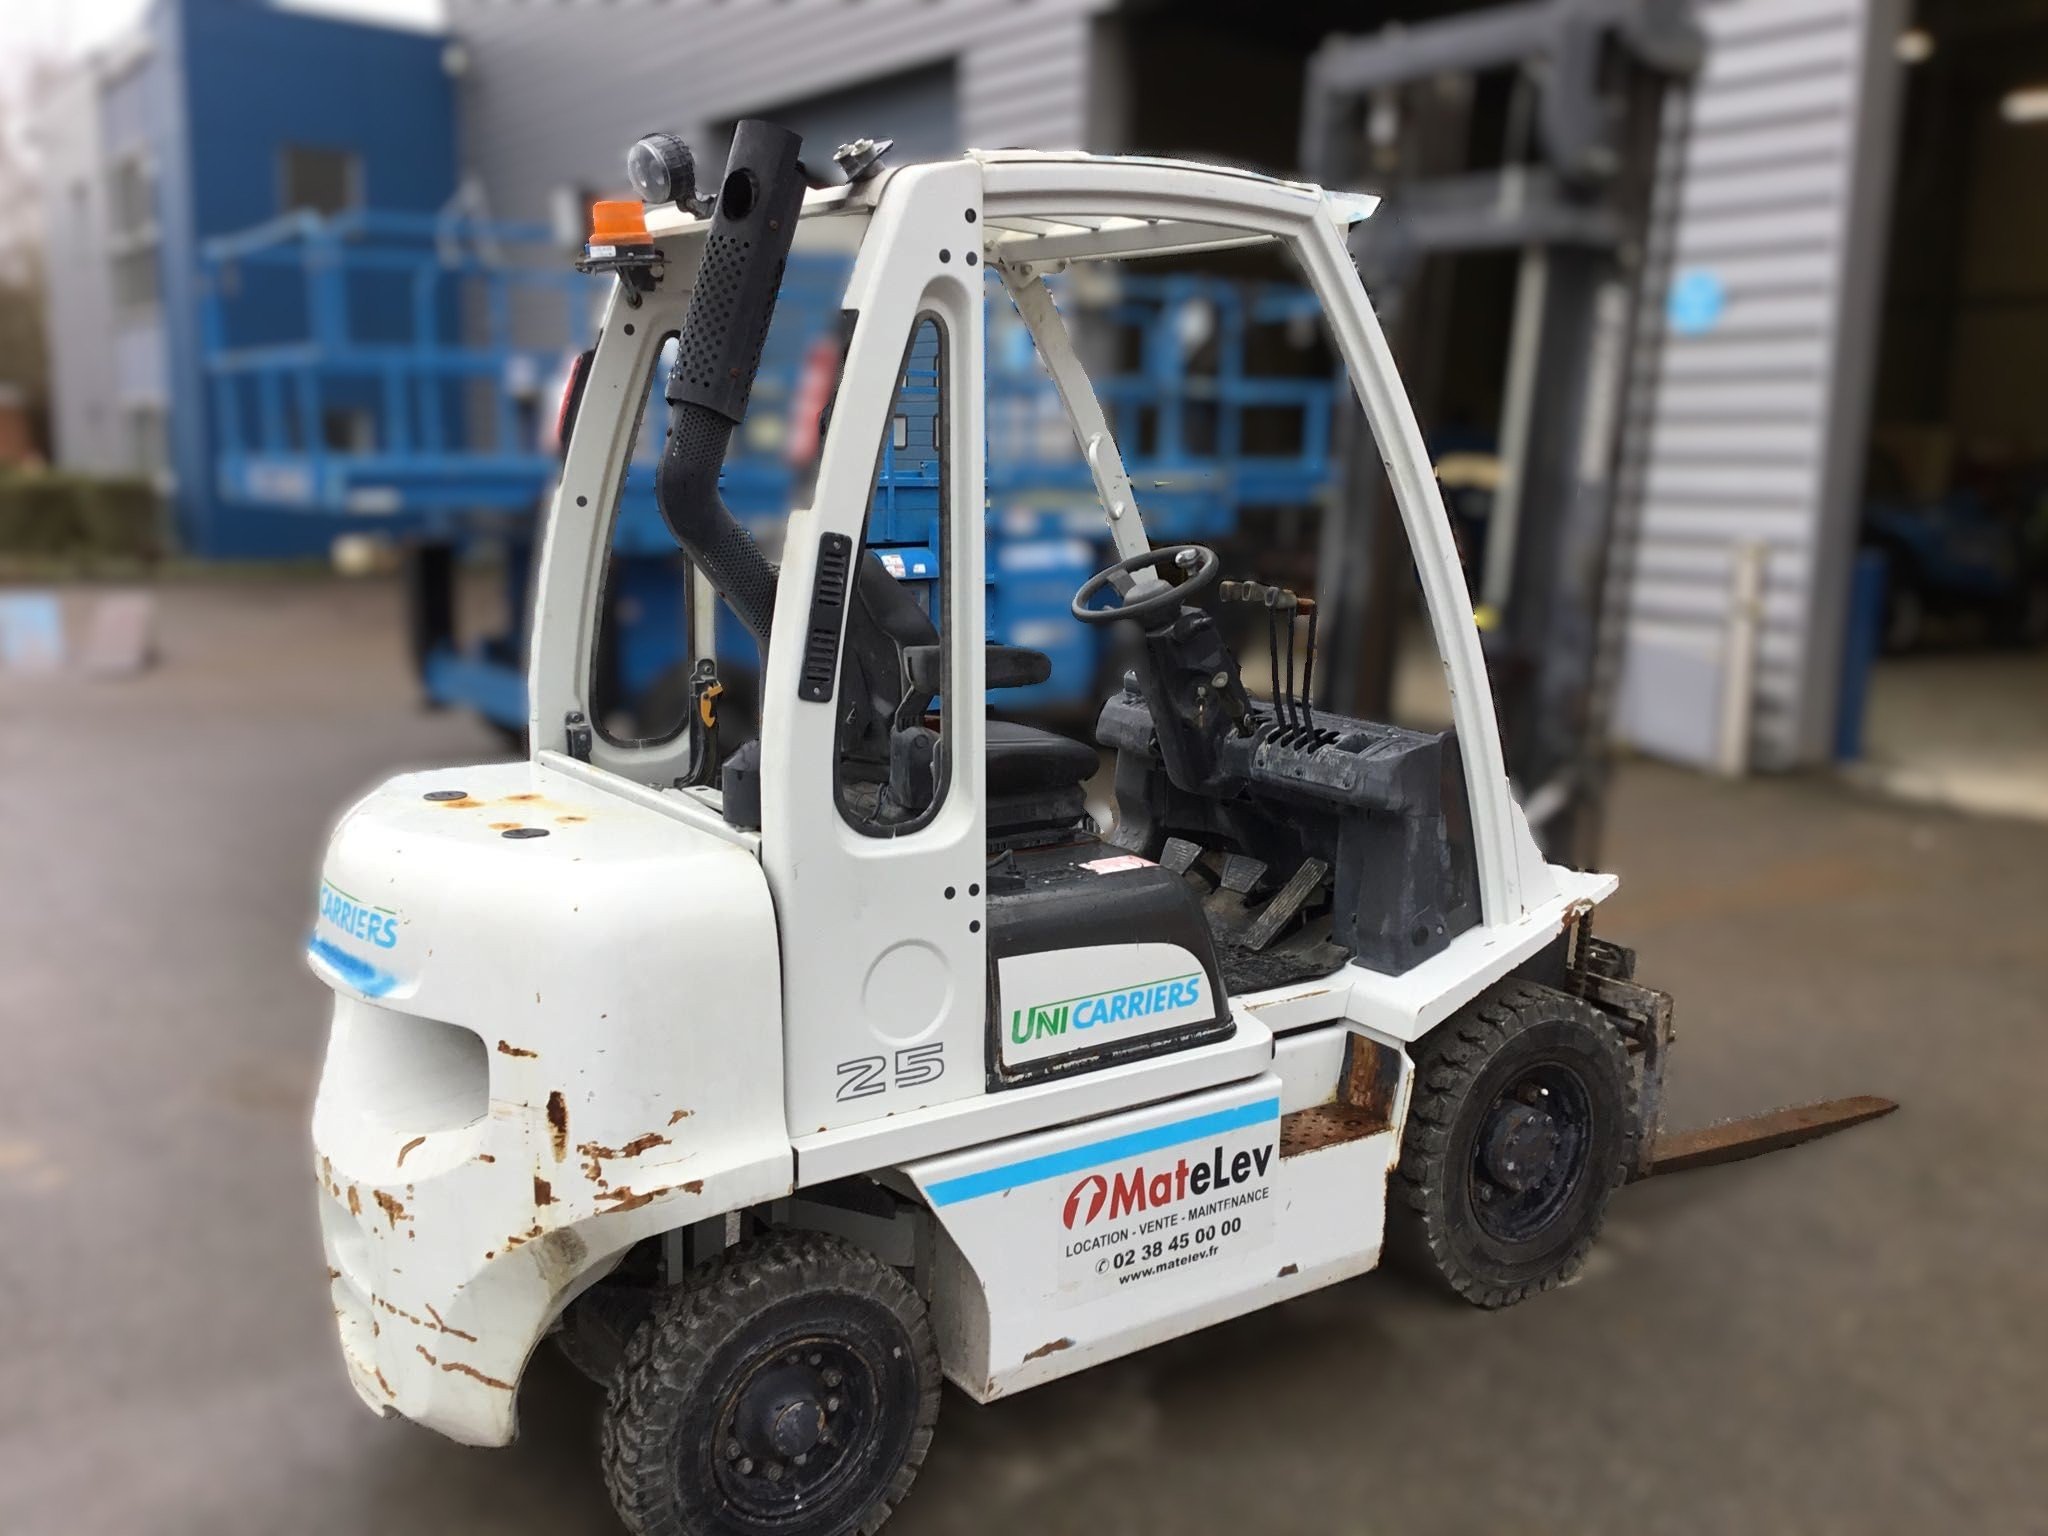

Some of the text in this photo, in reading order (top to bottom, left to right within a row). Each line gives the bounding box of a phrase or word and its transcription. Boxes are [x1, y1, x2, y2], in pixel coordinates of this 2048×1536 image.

[836, 1042, 945, 1103] 25
[1109, 1144, 1274, 1221] MateLev
[1066, 1228, 1129, 1258] LOCATION
[1139, 1213, 1178, 1236] VENTE
[1188, 1186, 1270, 1221] MAINTENANCE
[1113, 1217, 1242, 1270] 02 38 45 00 00
[1119, 1245, 1219, 1285] www.matelev.fr
